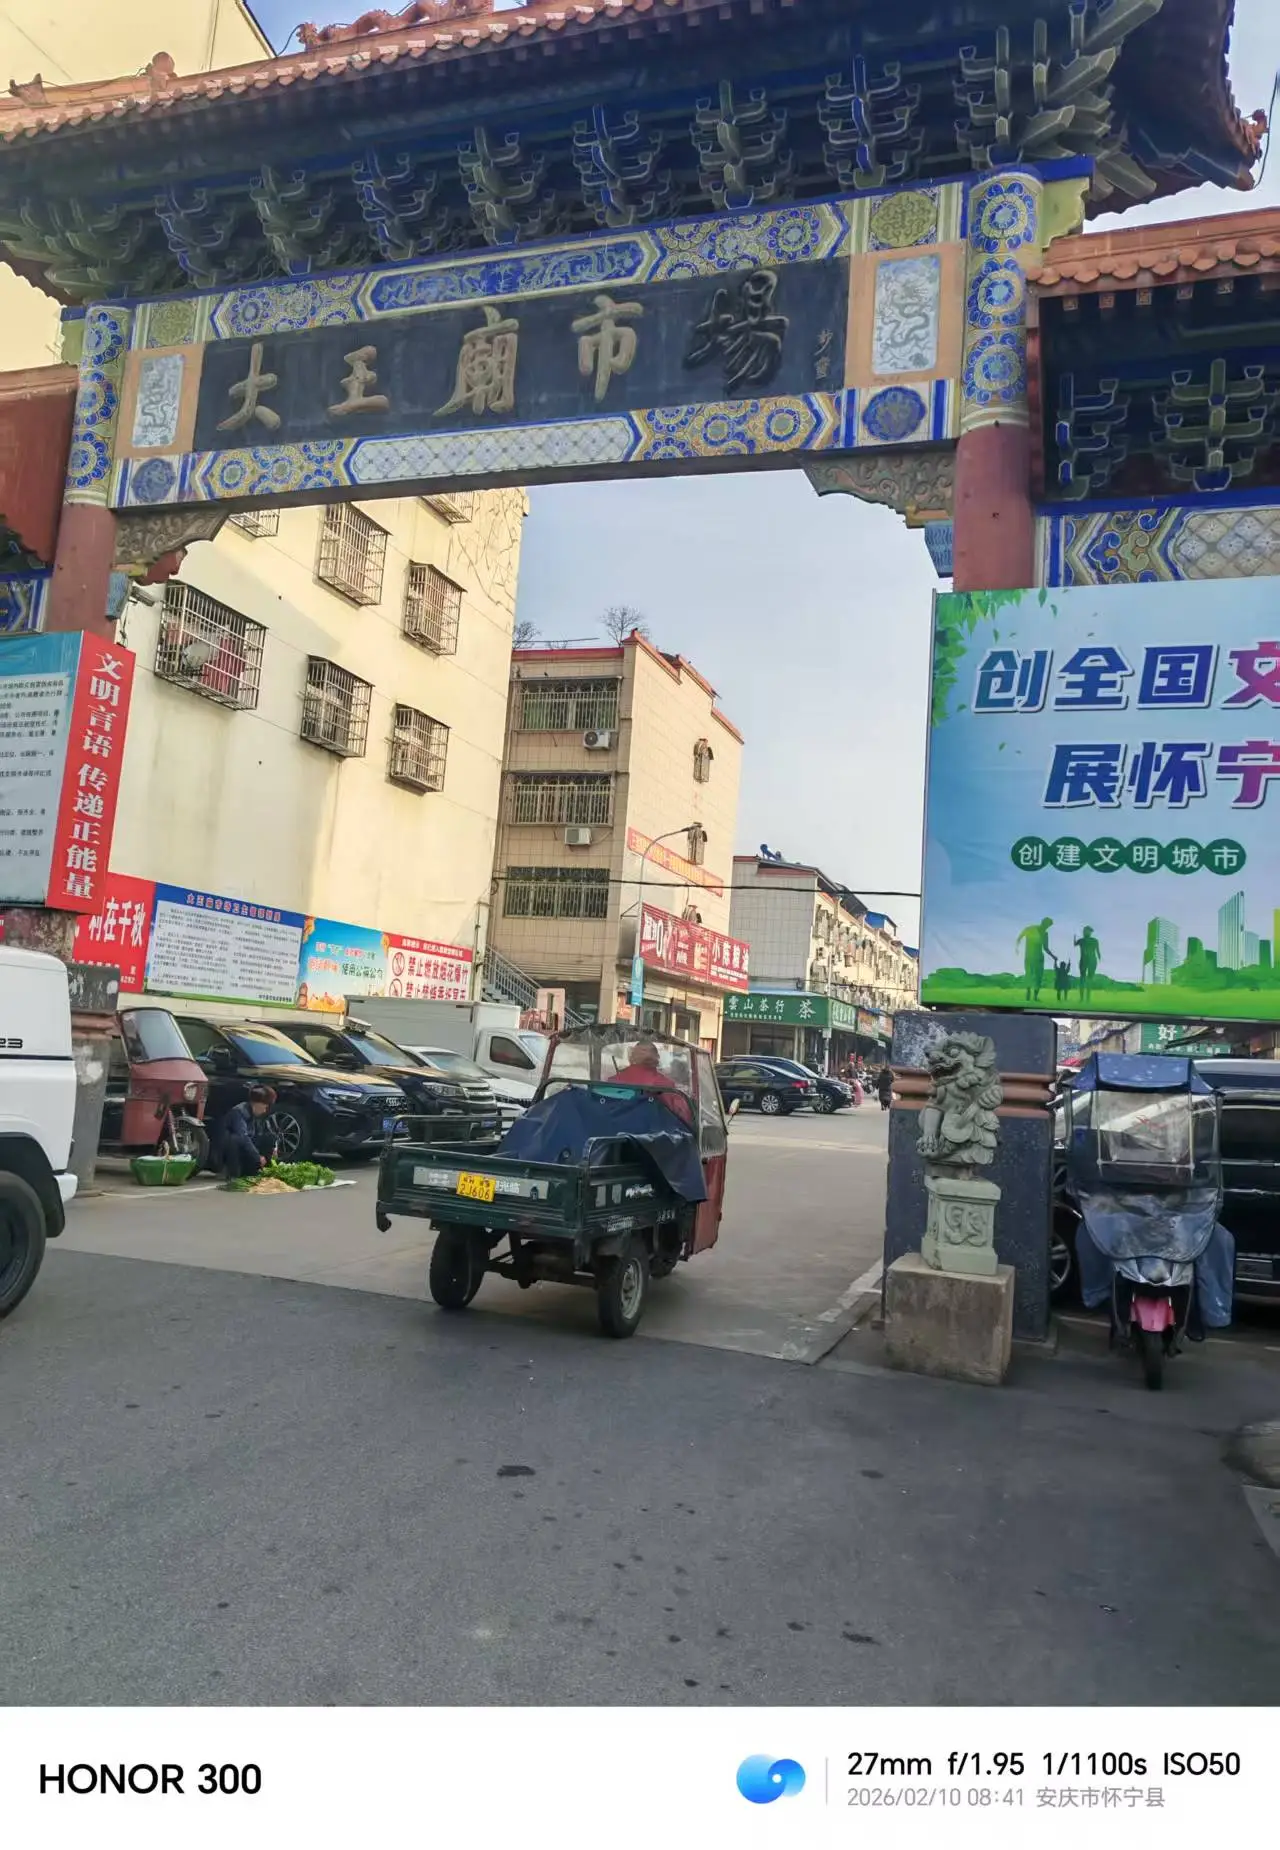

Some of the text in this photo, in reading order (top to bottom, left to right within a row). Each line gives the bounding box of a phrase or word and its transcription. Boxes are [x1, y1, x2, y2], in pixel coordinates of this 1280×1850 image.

[61, 653, 124, 900] 文明言语 传递正能量
[1043, 740, 1280, 808] 展怀宁
[1018, 842, 1240, 870] 创建文明城市
